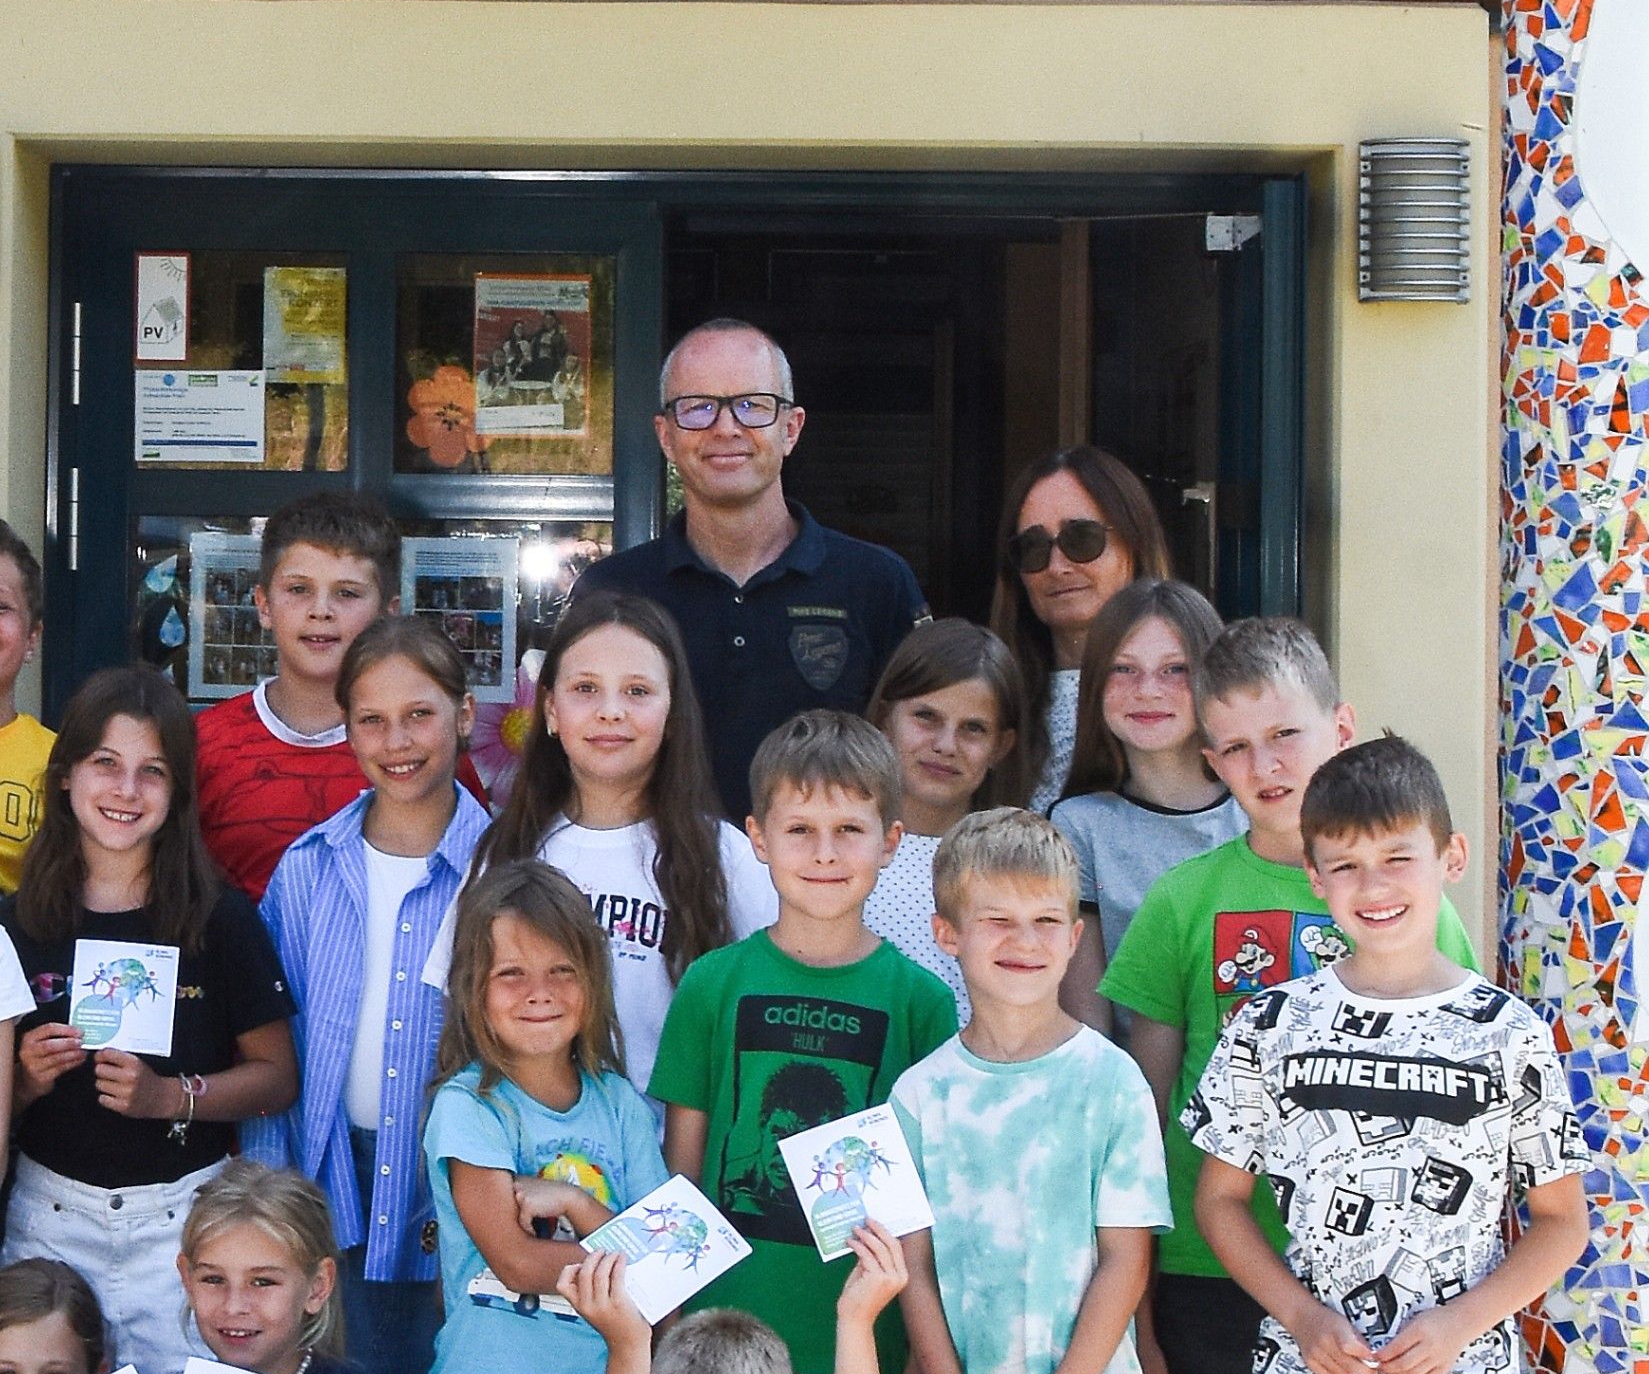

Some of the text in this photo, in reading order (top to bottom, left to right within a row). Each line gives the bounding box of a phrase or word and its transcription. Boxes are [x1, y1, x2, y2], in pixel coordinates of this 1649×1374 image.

[143, 326, 164, 339] PV
[764, 1003, 861, 1035] adidas
[1285, 1057, 1491, 1103] MINECRAFT
